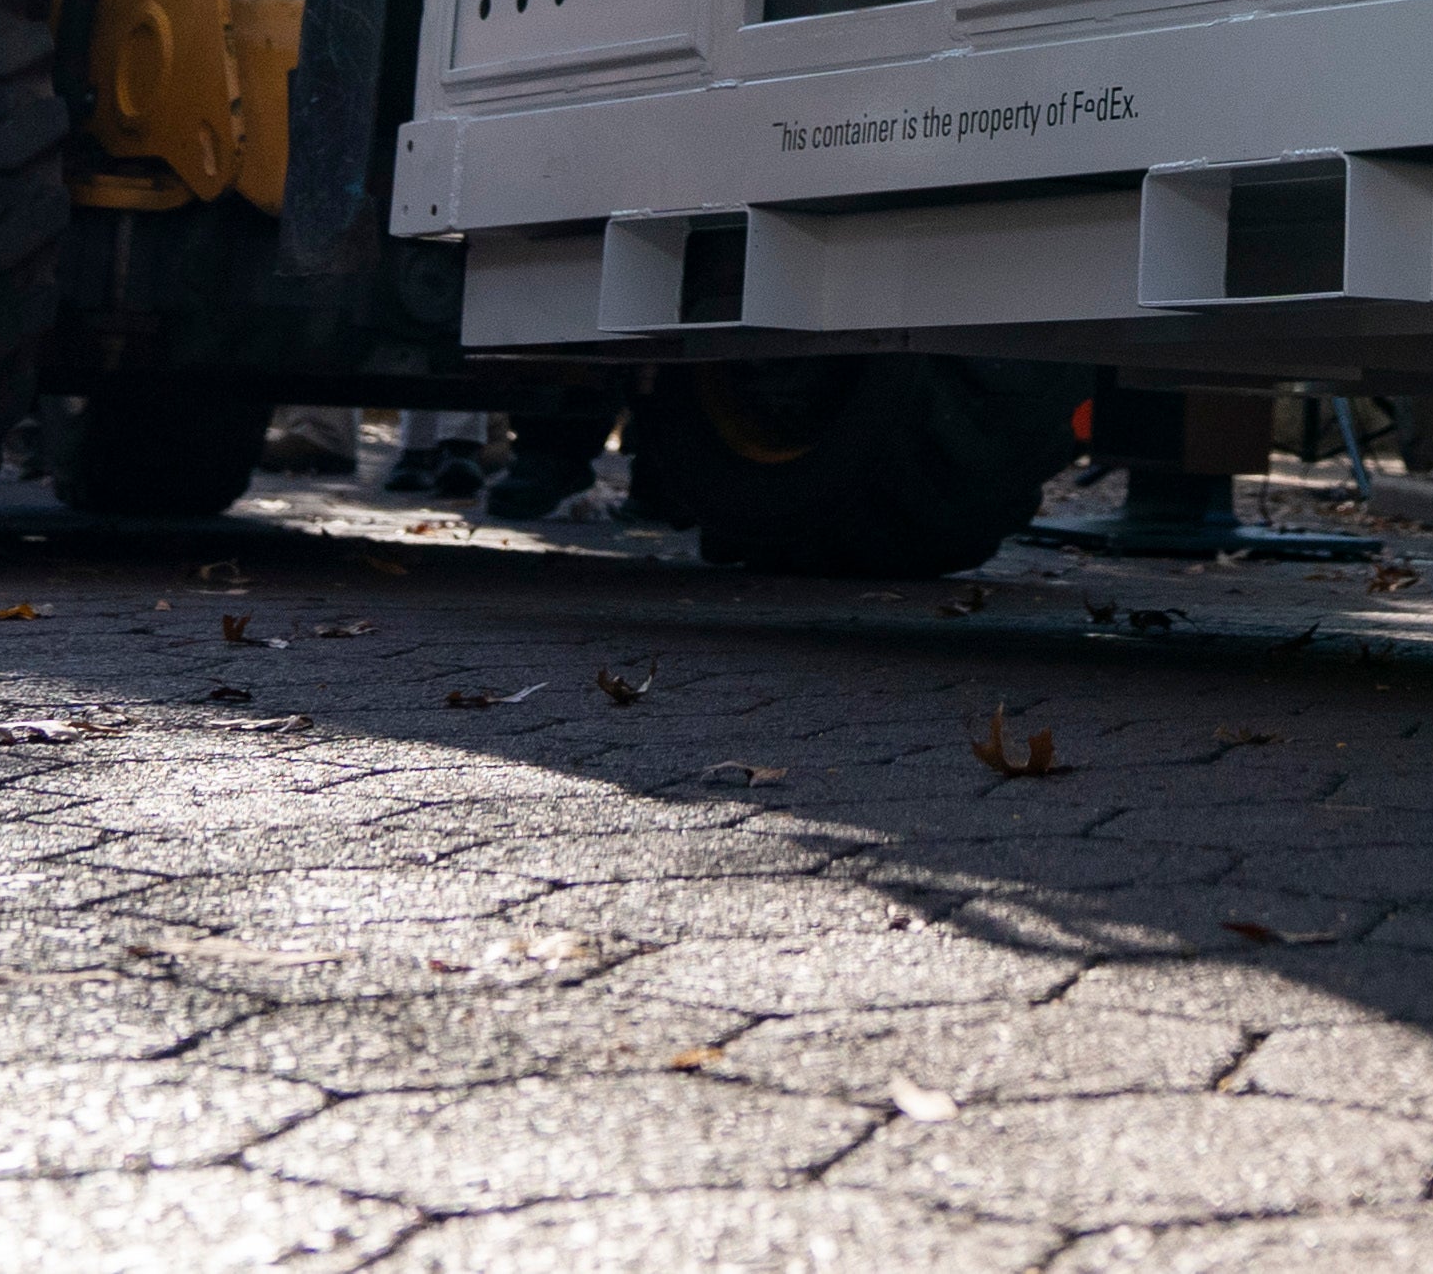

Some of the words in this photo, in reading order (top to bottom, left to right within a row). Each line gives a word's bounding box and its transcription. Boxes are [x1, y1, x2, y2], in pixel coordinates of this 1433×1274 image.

[812, 113, 898, 149] container
[902, 108, 917, 140] is
[923, 105, 953, 139] the
[958, 101, 1041, 143] property
[1047, 92, 1068, 127] of
